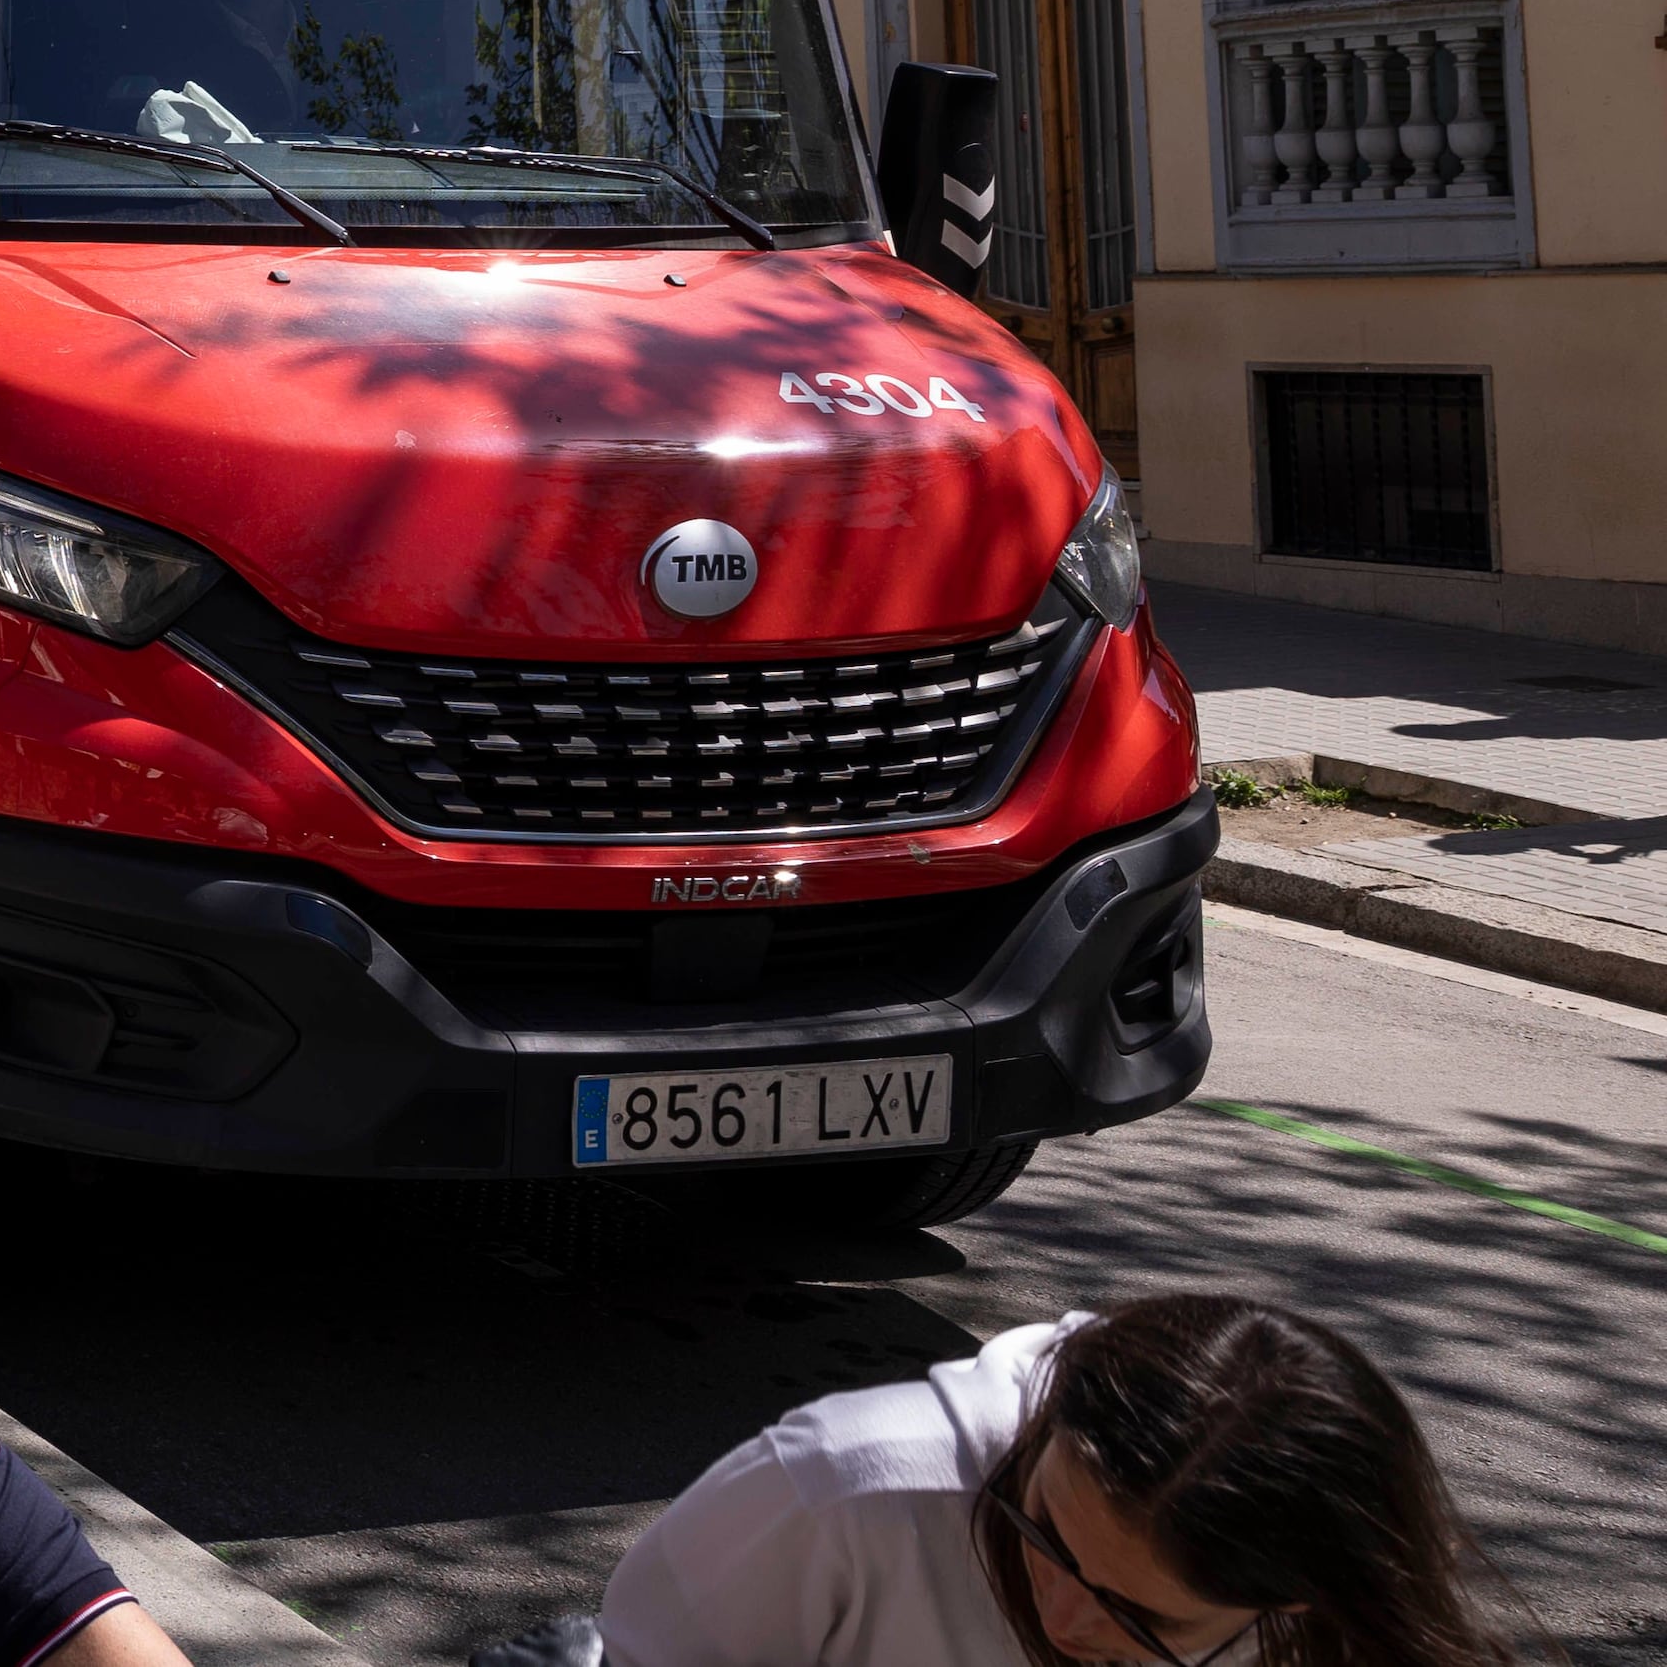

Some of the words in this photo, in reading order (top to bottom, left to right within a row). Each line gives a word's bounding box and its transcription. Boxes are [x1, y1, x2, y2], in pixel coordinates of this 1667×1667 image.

[778, 371, 986, 424] 4304
[671, 554, 748, 583] TMB
[650, 875, 801, 903] INDCAR
[622, 1080, 783, 1151] 8561
[818, 1070, 934, 1140] LXV
[585, 1129, 600, 1149] E
